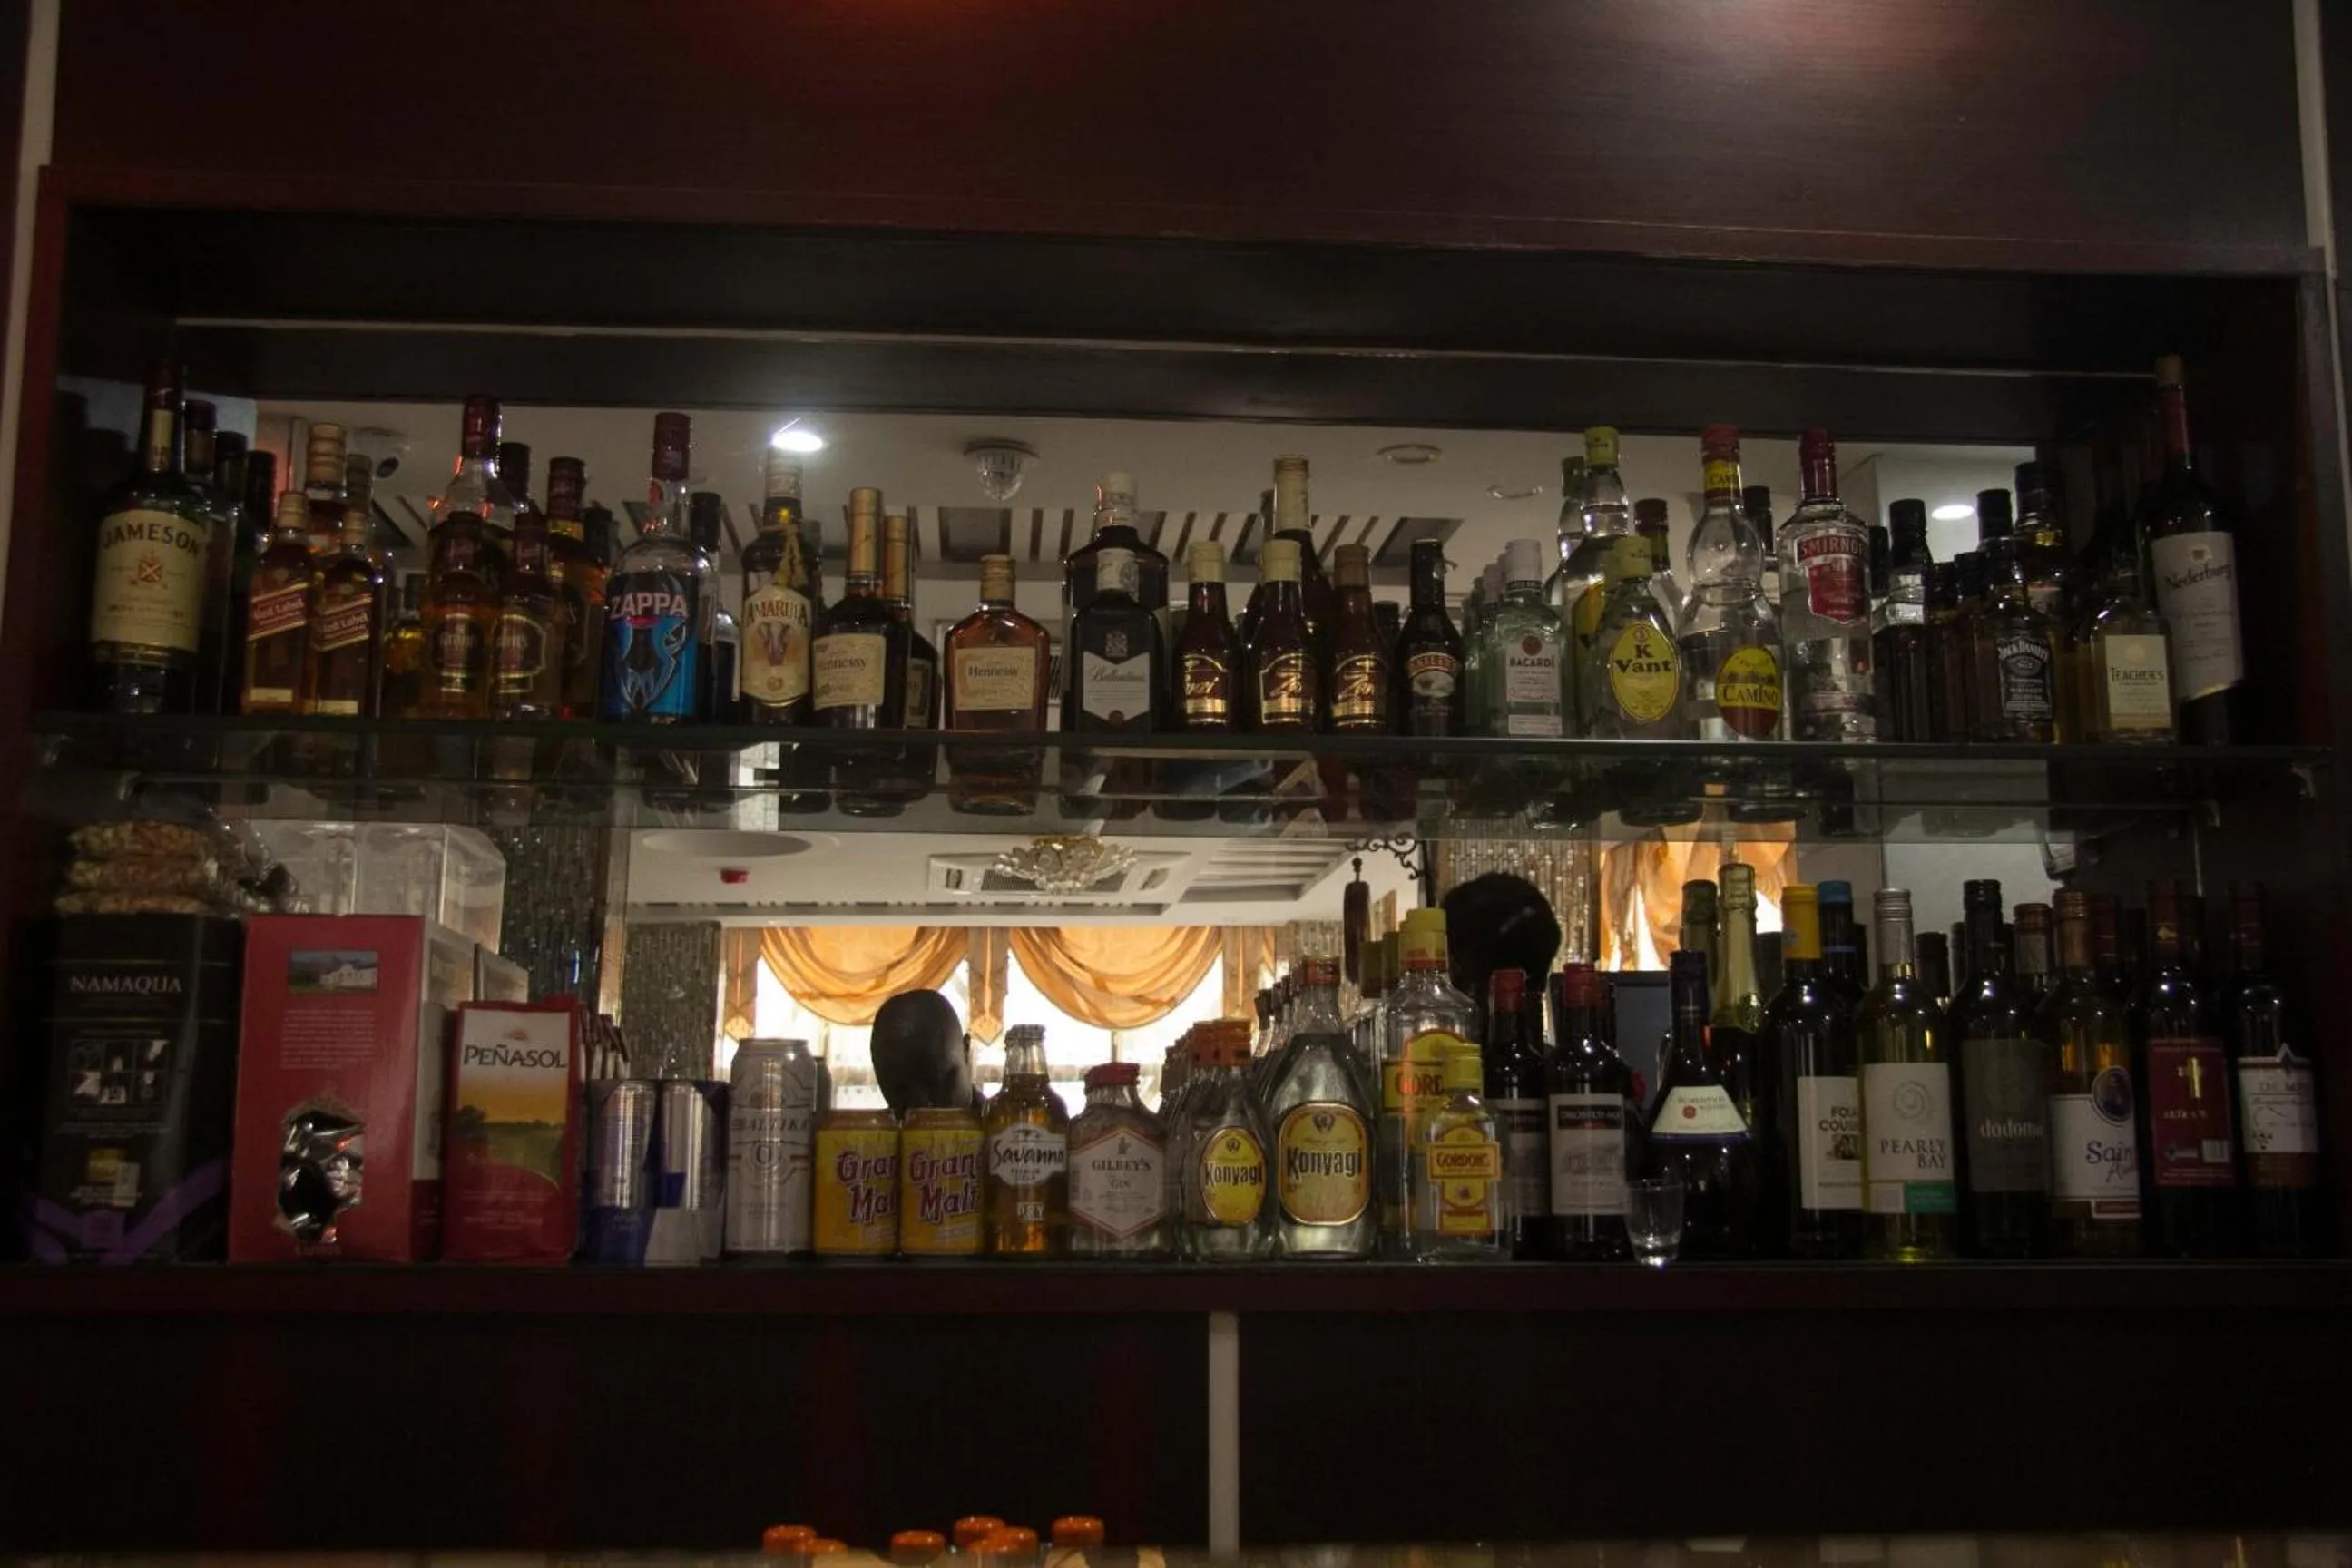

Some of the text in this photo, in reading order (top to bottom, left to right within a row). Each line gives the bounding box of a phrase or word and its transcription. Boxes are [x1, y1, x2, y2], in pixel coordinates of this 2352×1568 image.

[103, 523, 199, 559] JAMESON
[610, 593, 687, 620] ZAPPA
[746, 599, 808, 629] AMARULA
[1635, 644, 1652, 658] K
[1614, 659, 1672, 674] Vant
[68, 973, 183, 997] NAMAQUA
[463, 1044, 568, 1068] PEÑASOL
[1395, 1070, 1445, 1097] GORD
[991, 1140, 1063, 1171] Savanna
[1880, 1138, 1946, 1155] PEARLY
[2085, 1140, 2132, 1165] Sain
[1092, 1157, 1152, 1171] GILBEY'S
[1287, 1145, 1362, 1183] Konyagi
[1917, 1153, 1946, 1169] BAY
[1205, 1161, 1262, 1187] Konyagi
[849, 1183, 898, 1225] Mal
